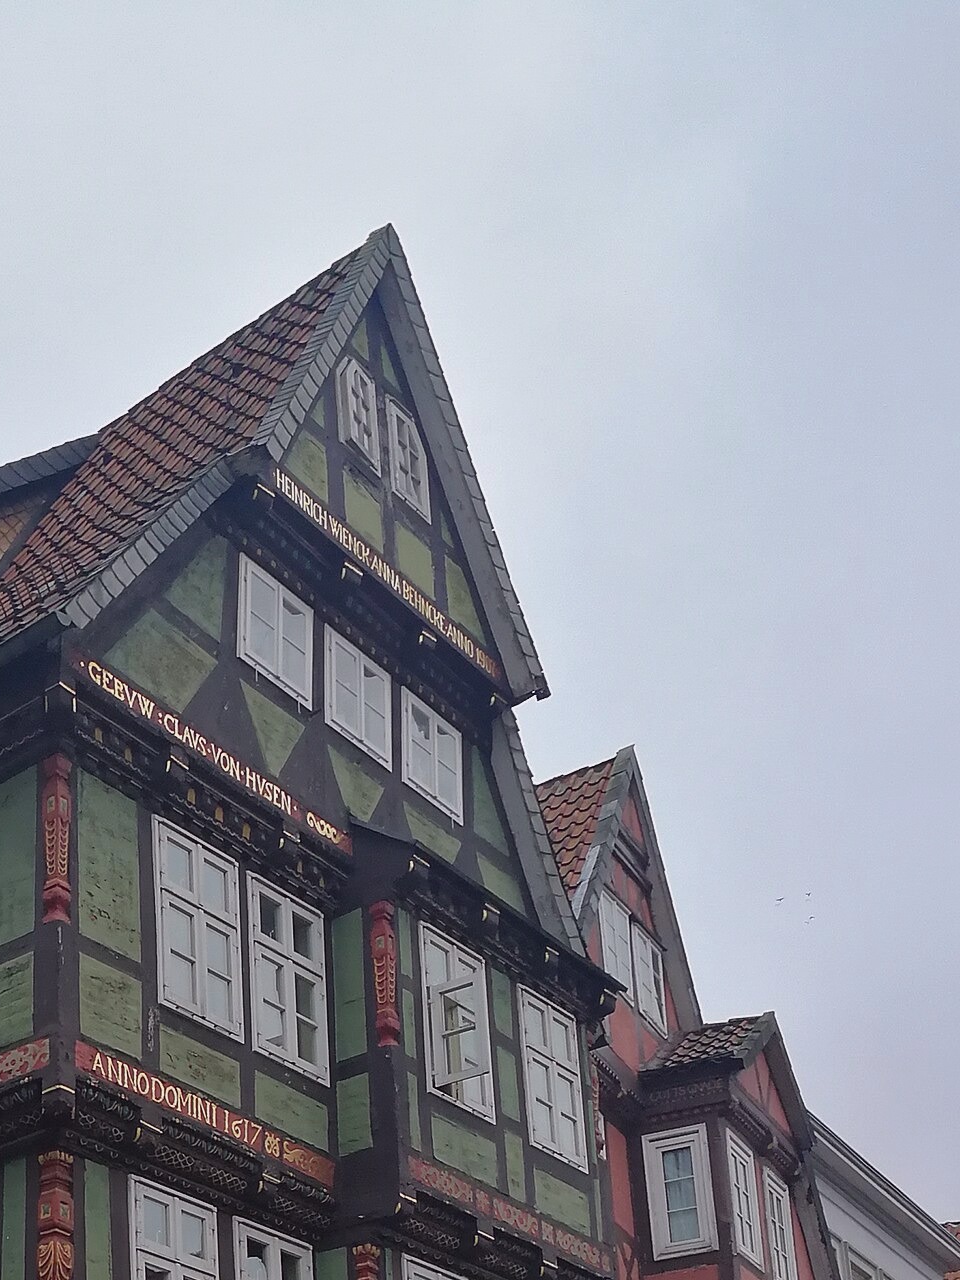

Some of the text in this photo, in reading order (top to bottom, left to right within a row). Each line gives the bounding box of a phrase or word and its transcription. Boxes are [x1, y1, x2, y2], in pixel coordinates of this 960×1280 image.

[276, 468, 328, 530] HEINRICH
[371, 555, 402, 594] ANNA
[446, 623, 474, 658] ANNO
[211, 748, 241, 781] VON
[245, 766, 292, 815] HVSEN
[92, 1052, 263, 1146] ANNO DOMINI 1617
